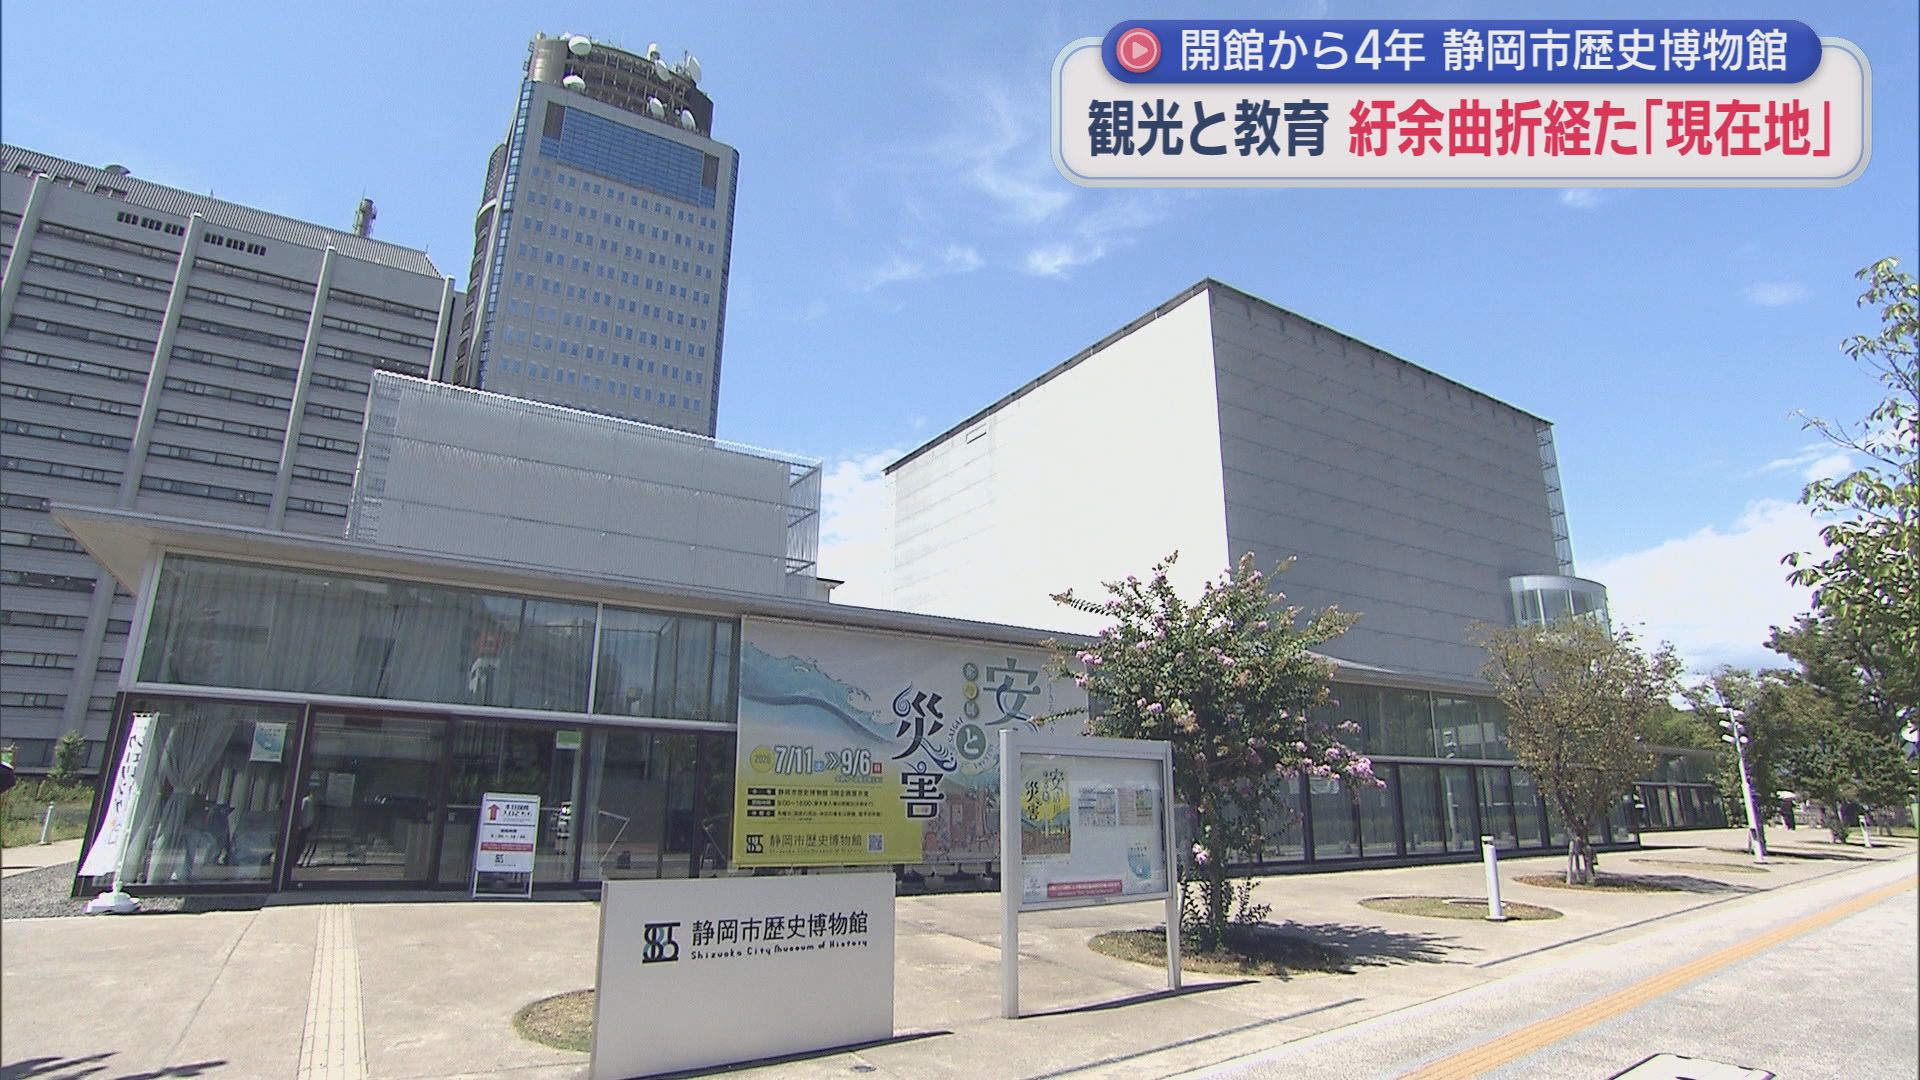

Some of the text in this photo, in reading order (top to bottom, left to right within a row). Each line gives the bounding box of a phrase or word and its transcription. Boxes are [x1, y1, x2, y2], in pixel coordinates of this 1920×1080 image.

[774, 745, 814, 774] 7/11
[841, 749, 872, 776] 9/6
[769, 834, 862, 848] 静岡市歴史博物館
[692, 911, 868, 946] 静岡市歴史博物館
[691, 949, 742, 960] Shizuoka
[747, 946, 771, 956] City
[774, 944, 814, 954] Museum
[829, 940, 868, 949] History
